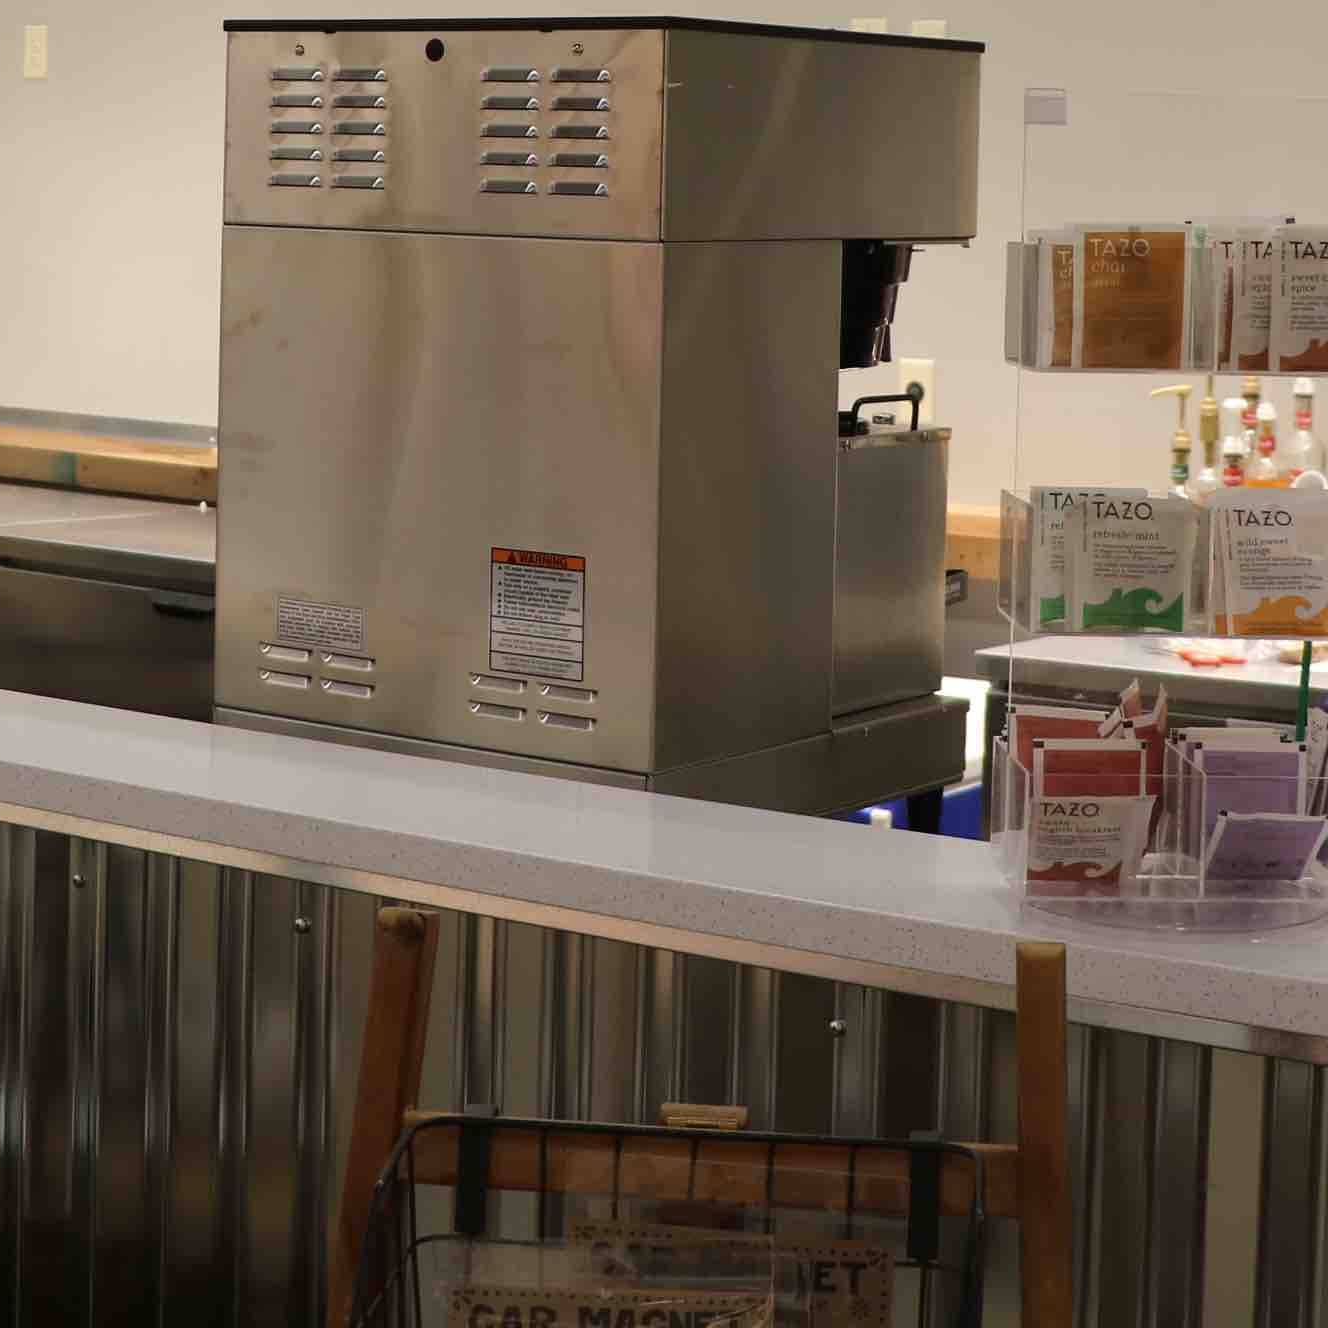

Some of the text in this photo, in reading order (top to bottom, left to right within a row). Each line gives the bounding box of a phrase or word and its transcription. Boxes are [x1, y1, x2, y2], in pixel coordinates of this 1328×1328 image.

[1089, 238, 1152, 257] TAZO
[1091, 501, 1154, 521] TAZO
[1232, 509, 1292, 527] TAZO
[518, 551, 569, 570] WARNING
[1039, 801, 1100, 818] TAZO
